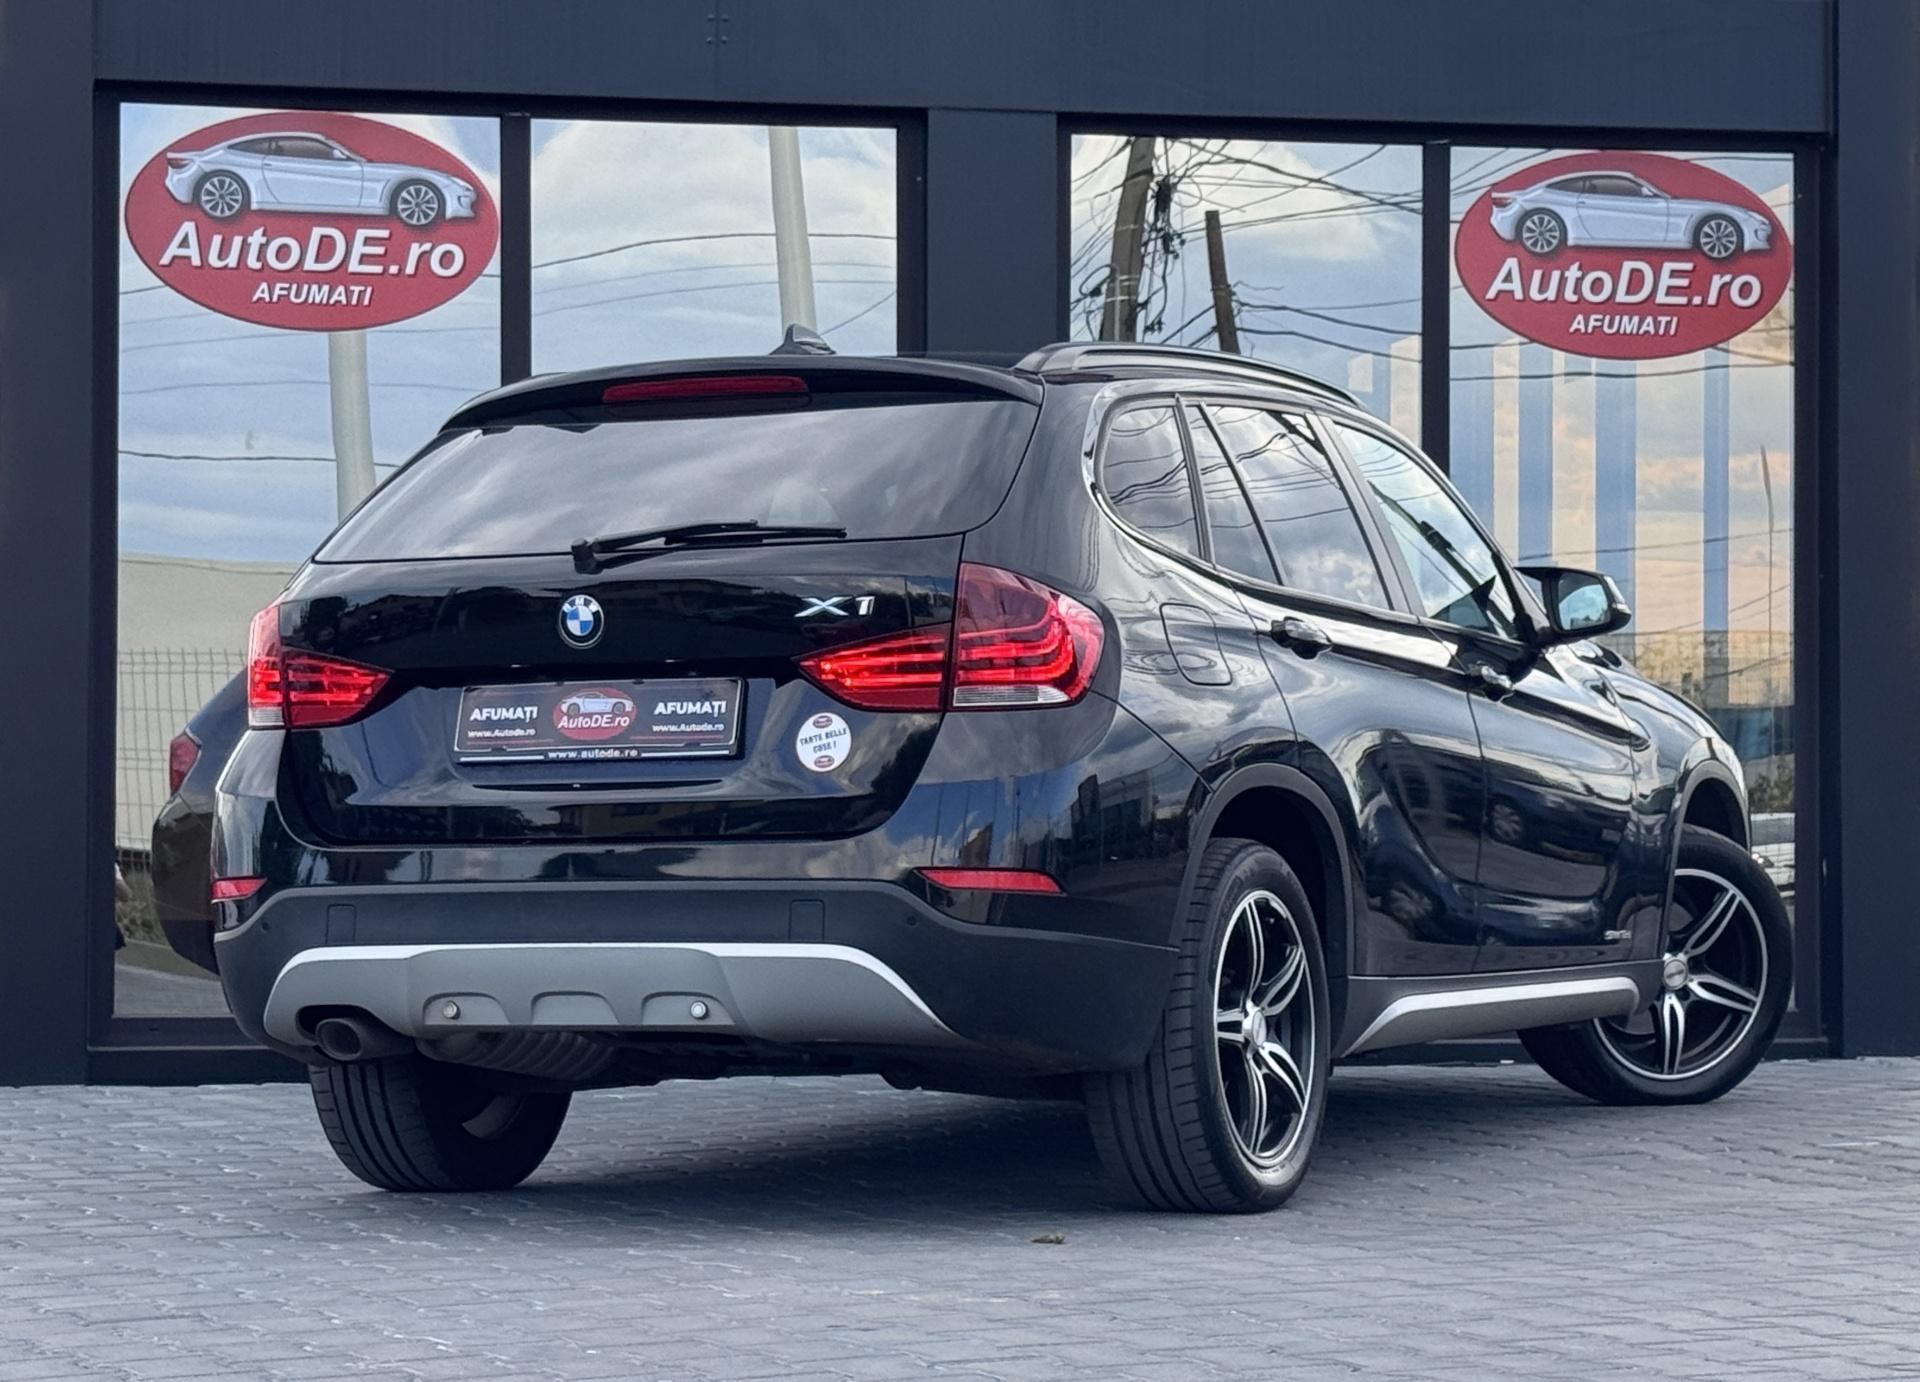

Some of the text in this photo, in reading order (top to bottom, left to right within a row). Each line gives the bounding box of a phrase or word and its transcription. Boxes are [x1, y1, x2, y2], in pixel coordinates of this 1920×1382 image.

[158, 221, 466, 278] AutoDE.ro
[1485, 257, 1763, 307] AutoDE.ro
[252, 282, 373, 307] AFUMATI
[1569, 314, 1679, 337] AFUMATI
[563, 597, 600, 613] BMW
[794, 596, 875, 618] X1
[557, 714, 630, 729] AutoDE.ro
[548, 749, 638, 758] www.autode.ro
